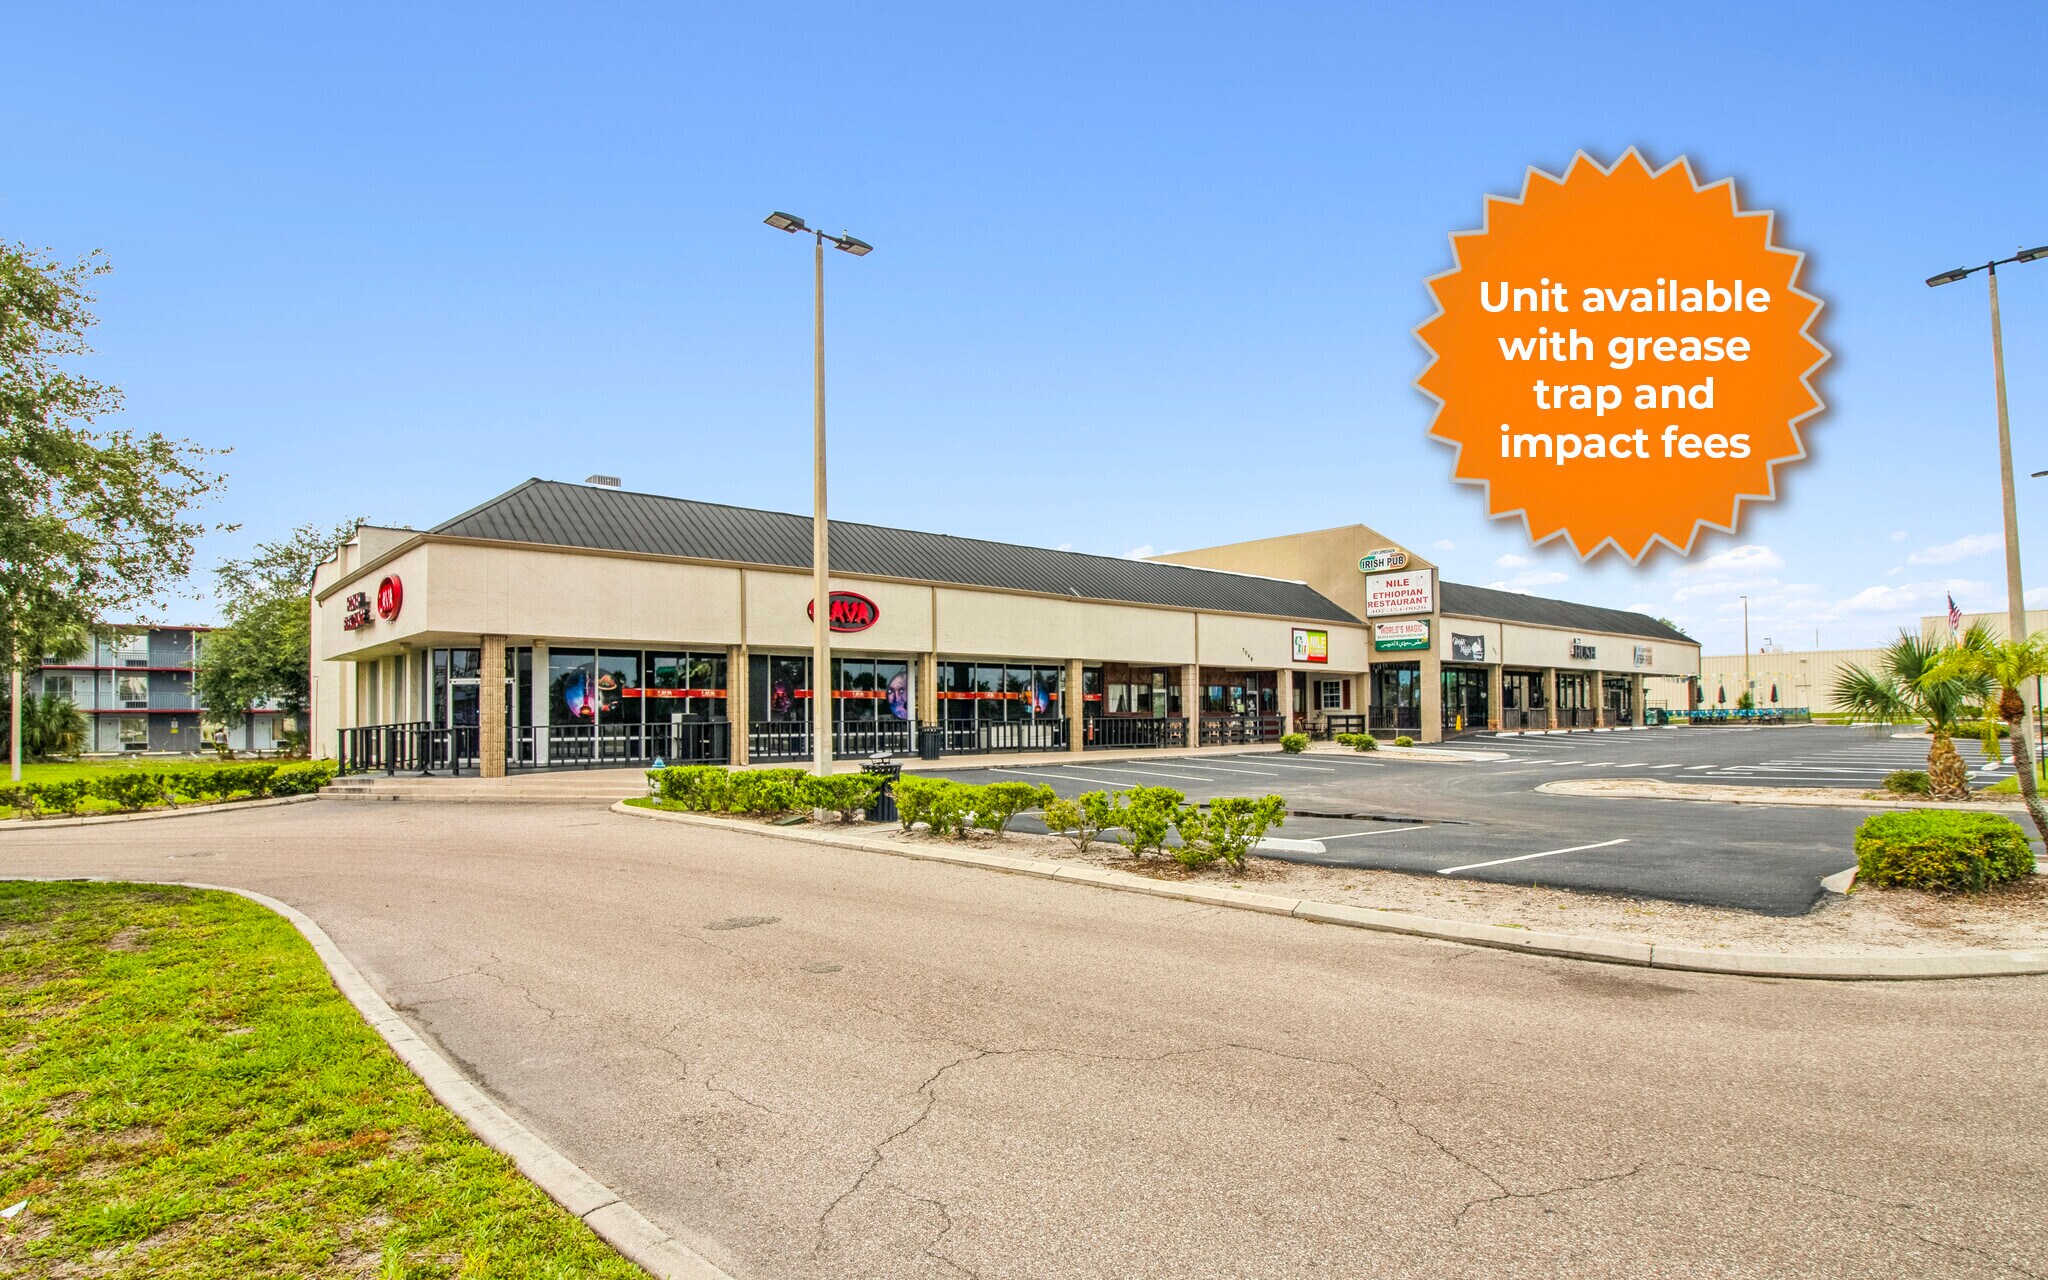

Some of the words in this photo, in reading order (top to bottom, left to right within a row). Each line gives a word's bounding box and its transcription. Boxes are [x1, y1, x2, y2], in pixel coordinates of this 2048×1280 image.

[1362, 559, 1385, 570] IRISH
[1387, 556, 1404, 567] PUB
[1385, 578, 1410, 588] NILE
[1372, 588, 1423, 600] ETHIOPIAN
[1367, 596, 1429, 609] RESTAURANT
[830, 599, 869, 625] AVA
[1380, 625, 1404, 635] WORLD'S
[1405, 624, 1423, 633] MAGIC
